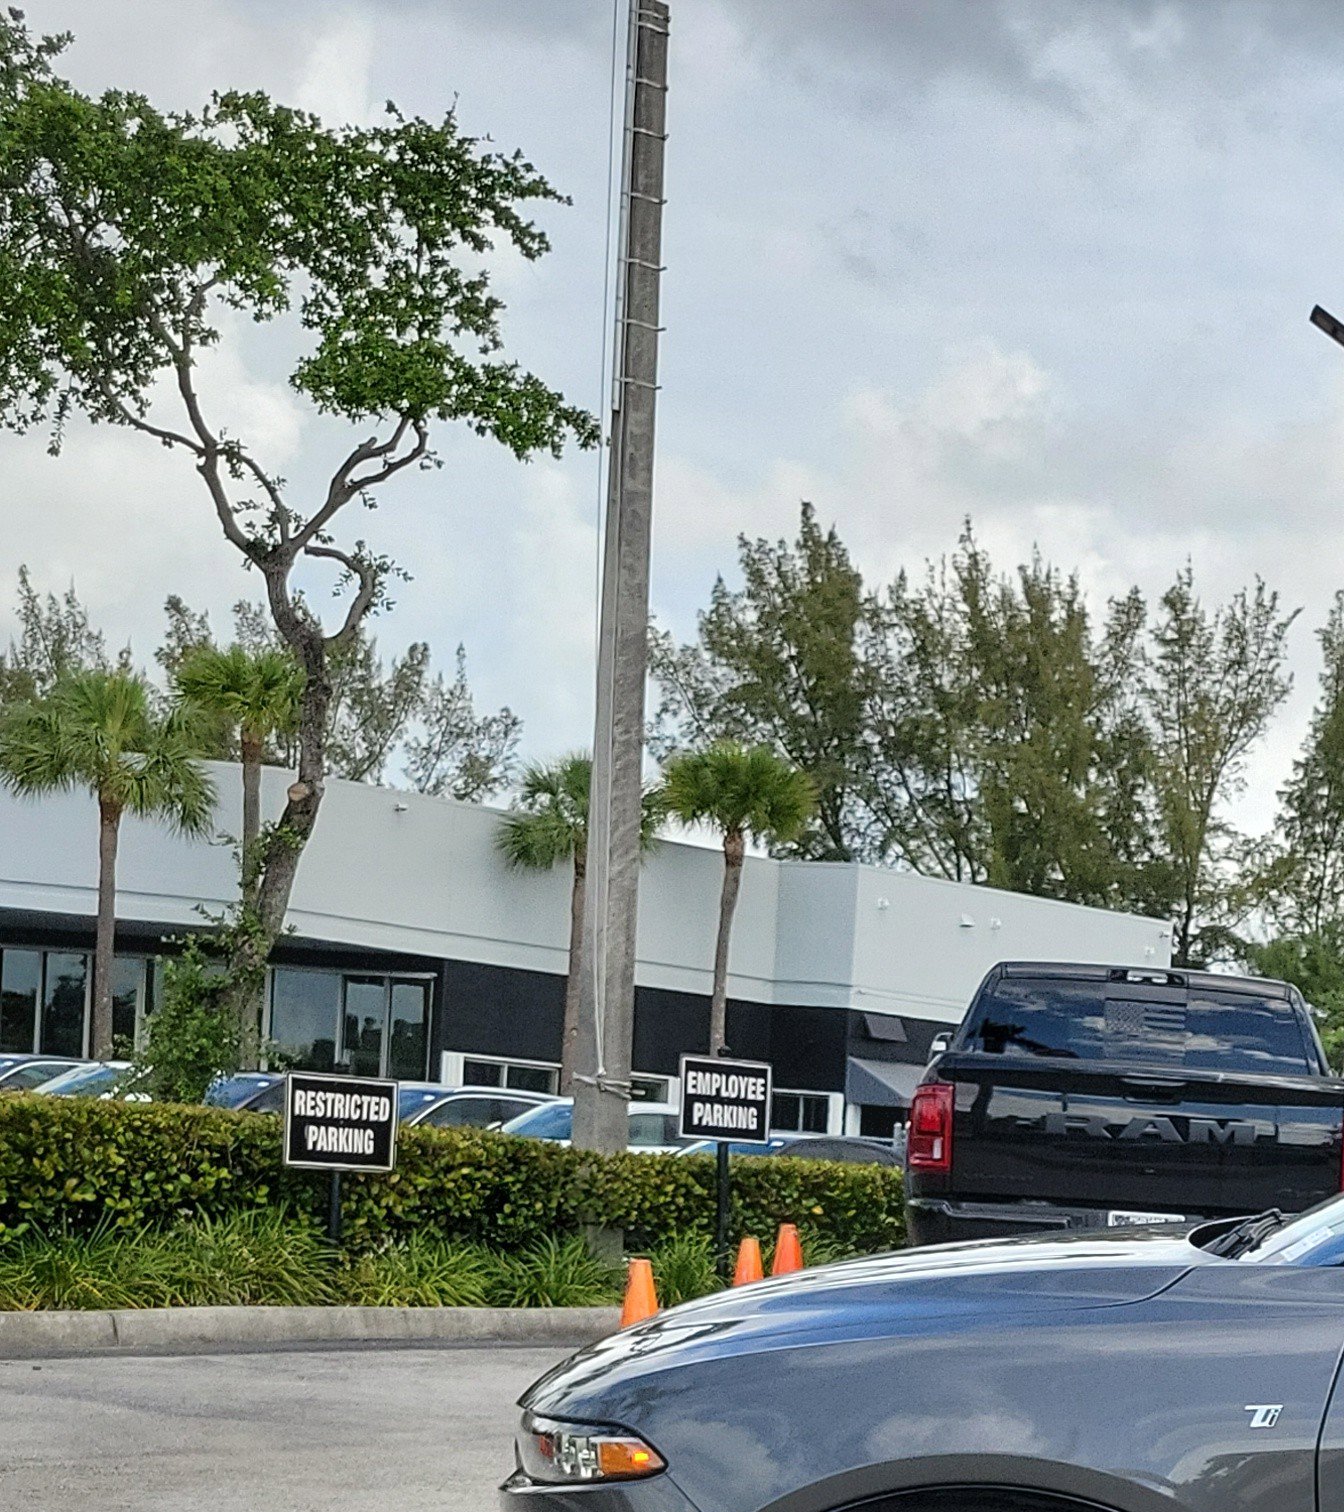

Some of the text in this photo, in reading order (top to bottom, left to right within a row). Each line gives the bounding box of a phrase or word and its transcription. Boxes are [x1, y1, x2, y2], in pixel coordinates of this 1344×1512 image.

[687, 1070, 765, 1101] EMPLOYEE
[294, 1089, 390, 1122] RESTRICTED
[692, 1101, 758, 1130] PARKING
[306, 1124, 375, 1155] PARKING
[1045, 1112, 1257, 1144] RAM
